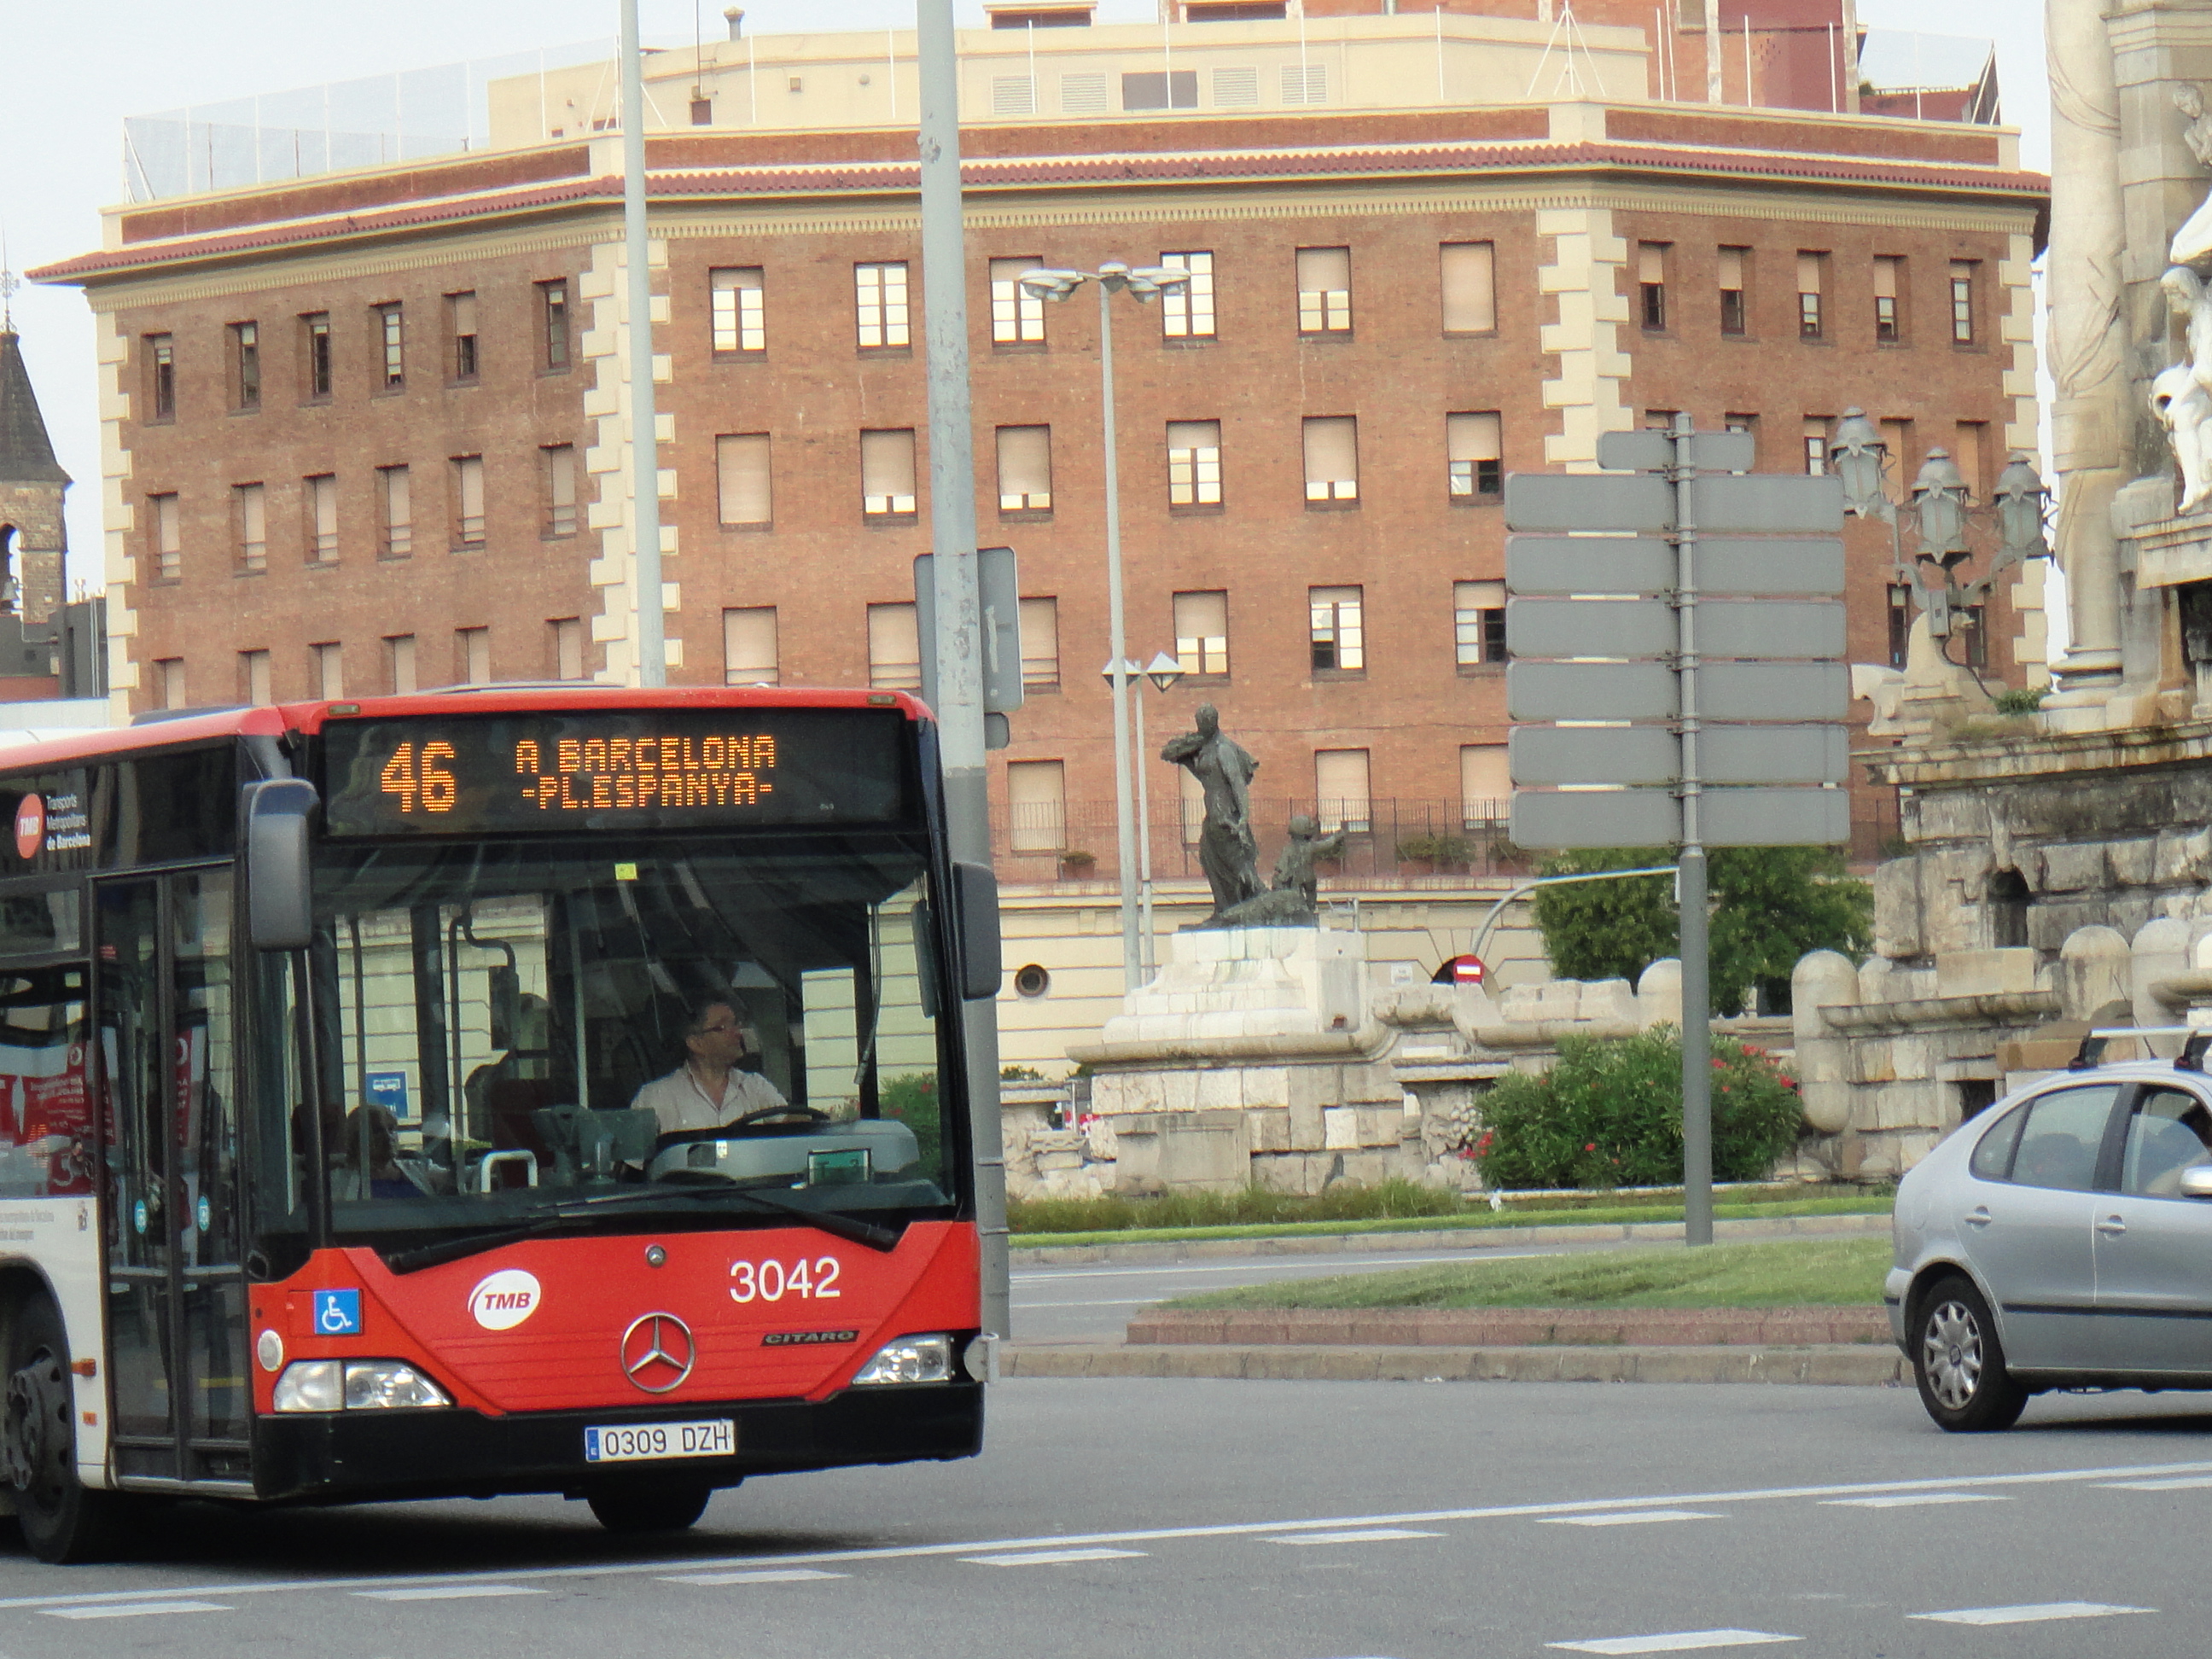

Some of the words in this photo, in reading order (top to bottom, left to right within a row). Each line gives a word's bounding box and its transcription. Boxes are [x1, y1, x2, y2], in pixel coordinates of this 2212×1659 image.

[381, 742, 455, 812] 46
[516, 739, 538, 773] A
[559, 736, 775, 772] BARCELONA
[20, 815, 39, 837] TMB
[730, 1255, 841, 1303] 3042
[484, 1291, 532, 1311] TMB
[765, 1330, 855, 1344] CITARO
[604, 1428, 667, 1457] 0309
[682, 1424, 729, 1452] DZH
